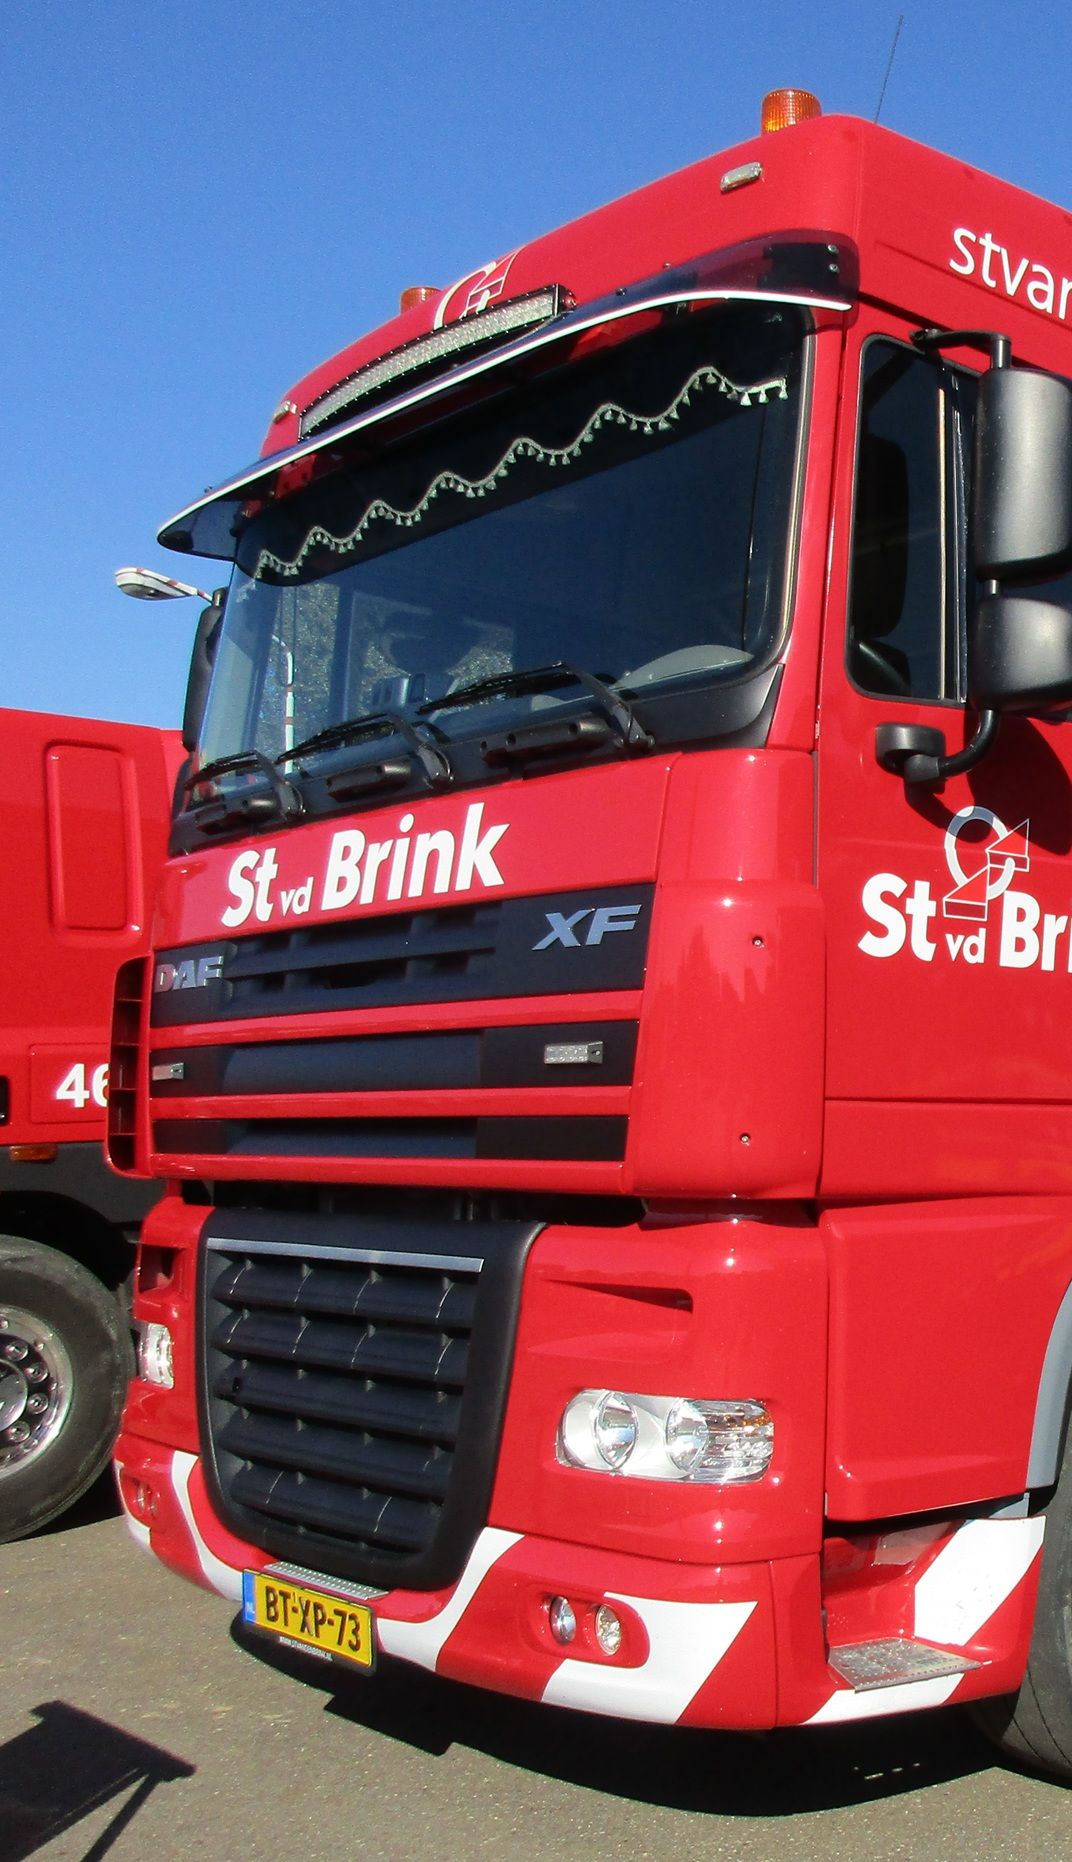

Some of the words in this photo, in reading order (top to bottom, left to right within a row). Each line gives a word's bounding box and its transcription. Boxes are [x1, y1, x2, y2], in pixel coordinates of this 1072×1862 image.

[220, 847, 279, 928] St
[280, 876, 314, 917] vd
[320, 801, 511, 911] Brink
[532, 904, 643, 951] XF
[858, 872, 936, 962] St
[945, 927, 987, 964] vd
[154, 955, 224, 993] DAF
[265, 1585, 362, 1652] BT-XP-73
